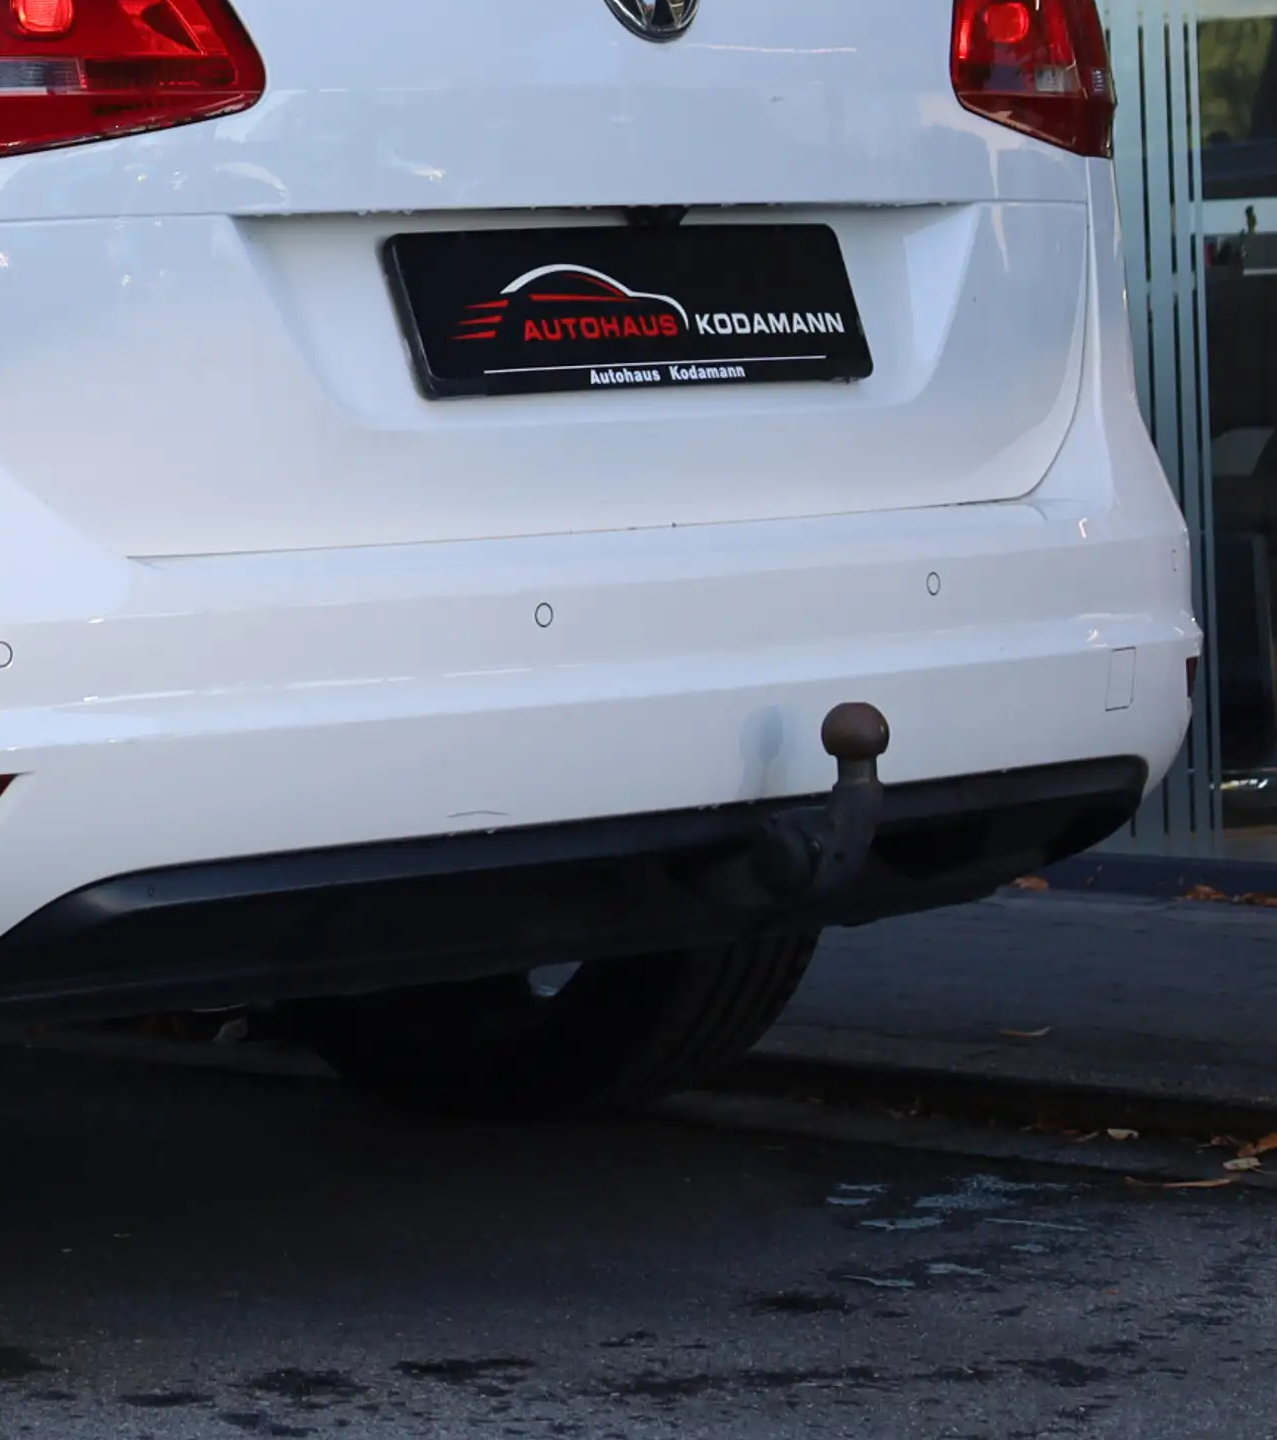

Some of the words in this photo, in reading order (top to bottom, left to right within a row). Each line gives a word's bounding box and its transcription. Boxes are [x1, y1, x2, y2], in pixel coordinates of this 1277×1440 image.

[524, 314, 678, 341] AUTOHAUS
[695, 312, 845, 335] KODAMANN
[590, 368, 660, 385] Autohaus
[669, 363, 745, 382] Kodamann
